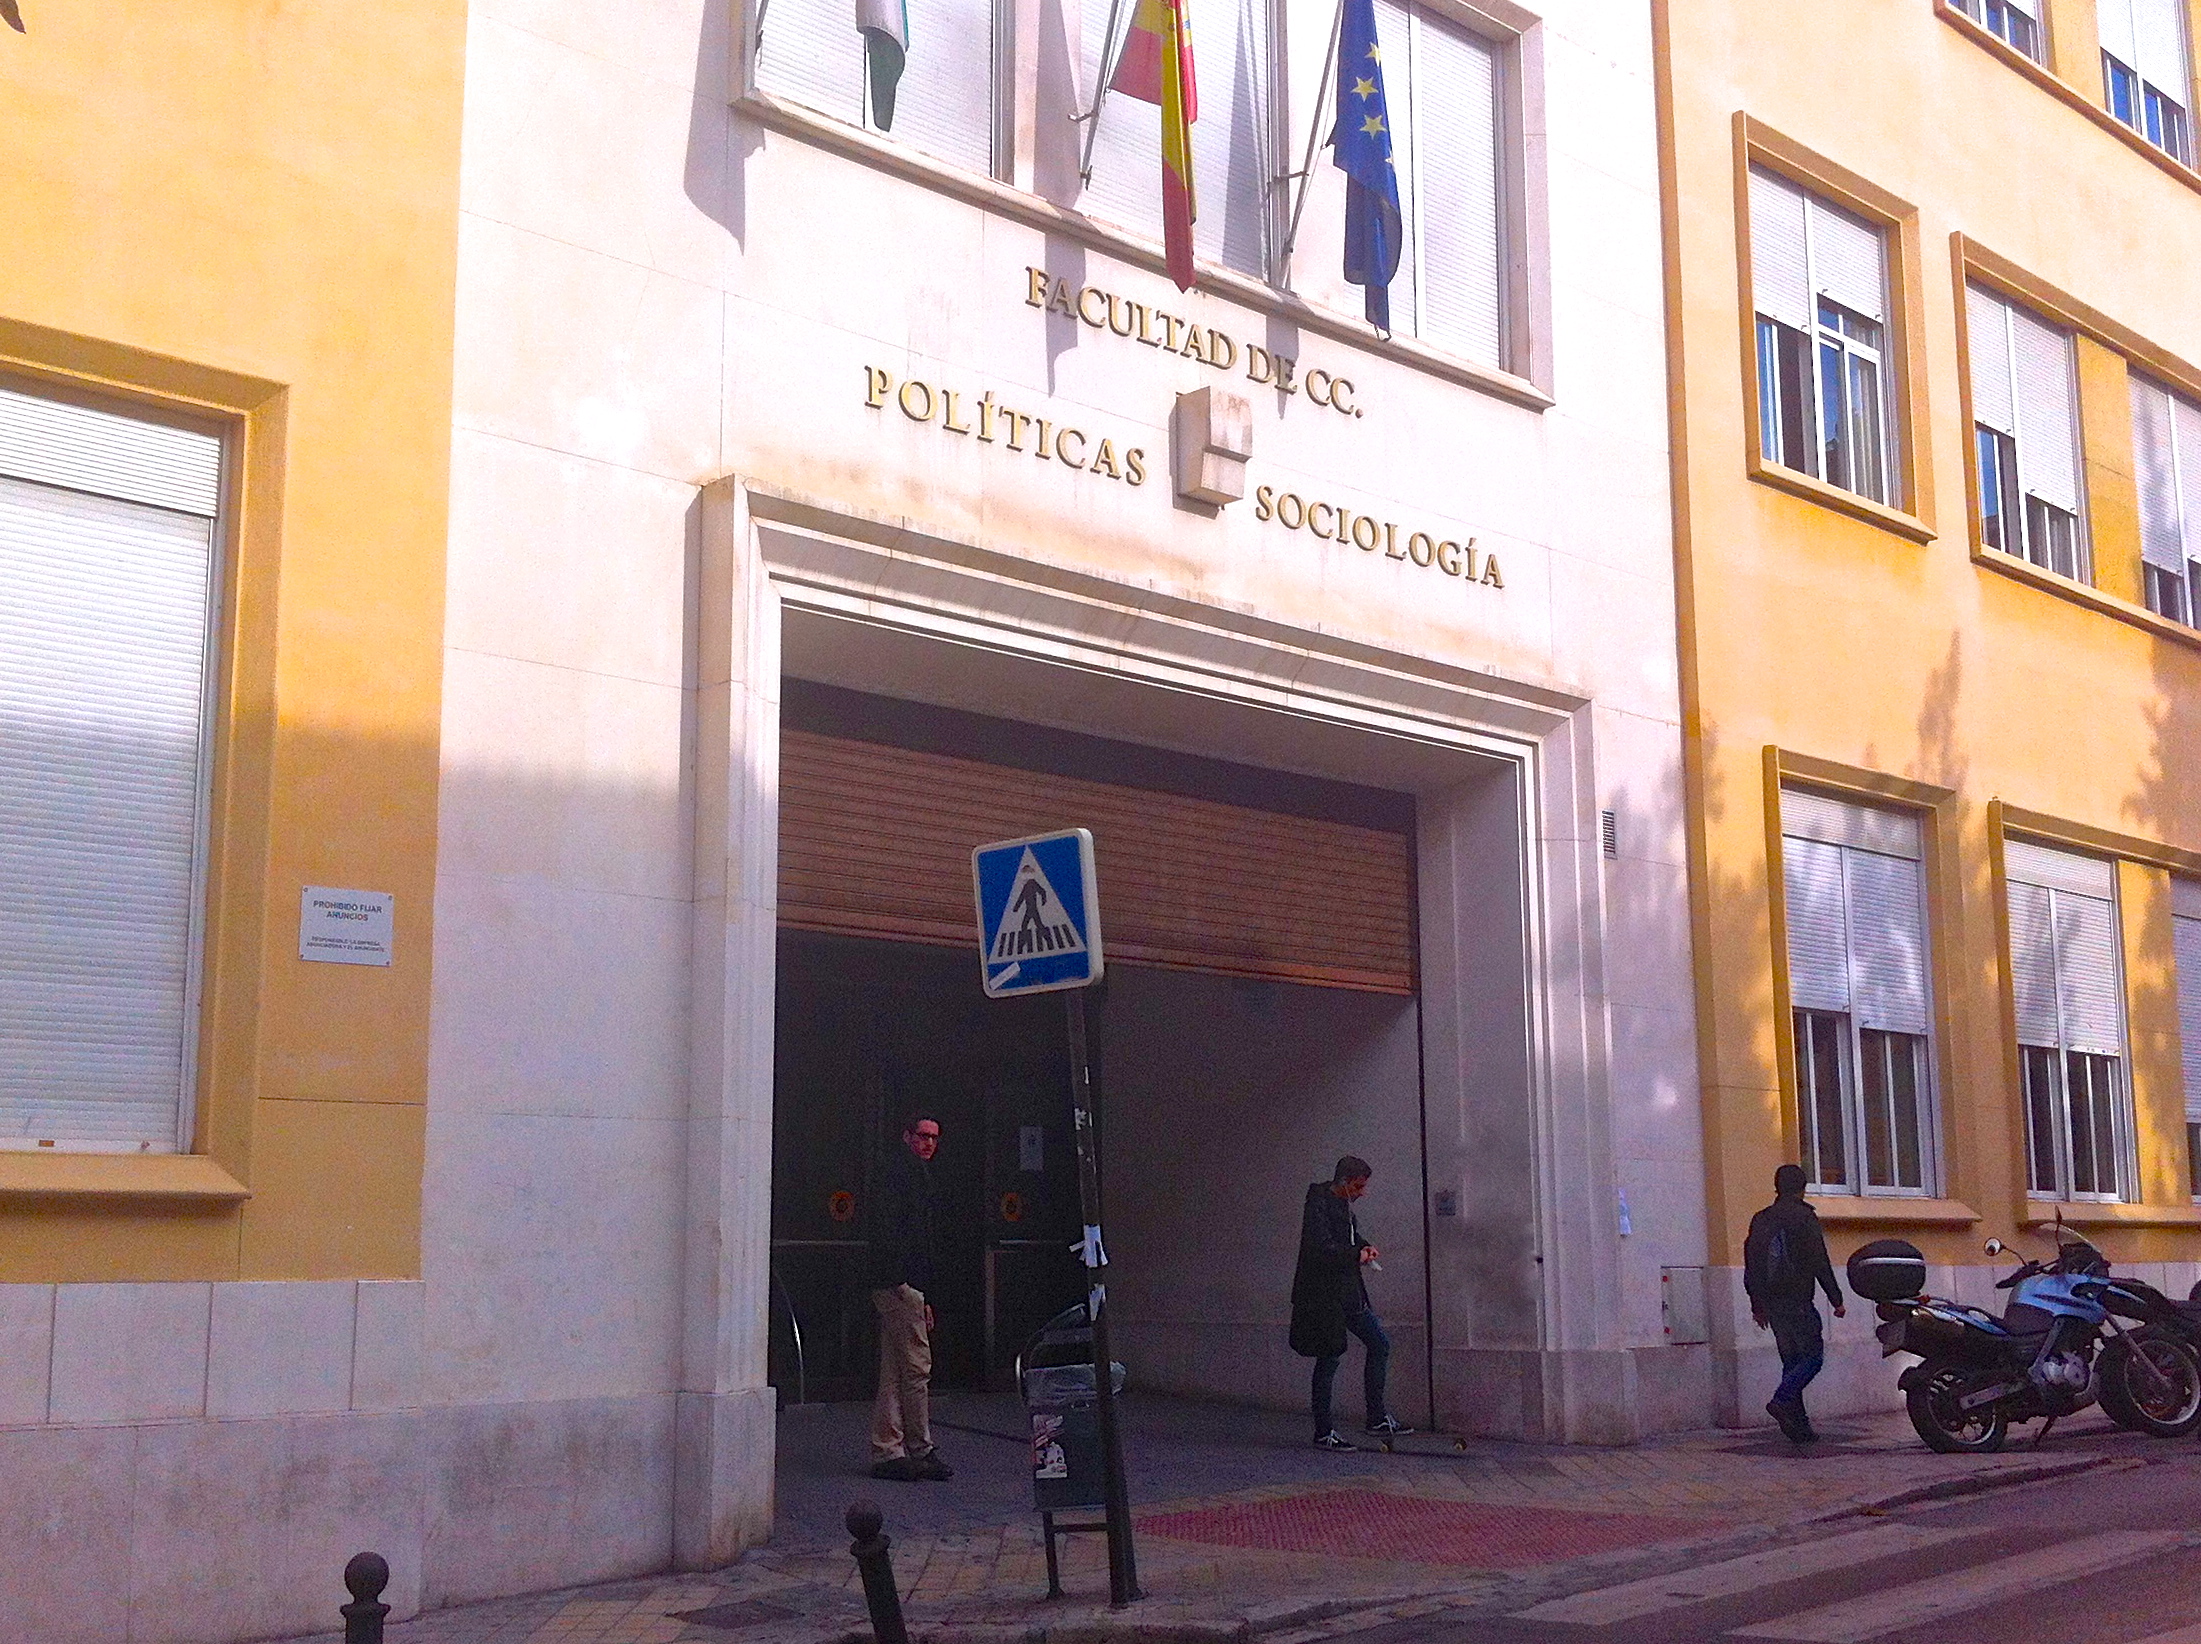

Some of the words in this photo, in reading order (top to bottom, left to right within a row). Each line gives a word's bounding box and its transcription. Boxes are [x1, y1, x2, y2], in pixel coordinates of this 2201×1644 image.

[1025, 265, 1237, 371] FACULTAD
[1246, 343, 1297, 394] DE
[1304, 368, 1364, 419] CC.
[863, 364, 1146, 486] POLÍTICAS
[1255, 485, 1505, 589] SOCIOLOGÍA
[313, 901, 358, 911] PROHIBIDO
[326, 911, 368, 921] ANUNCIOS
